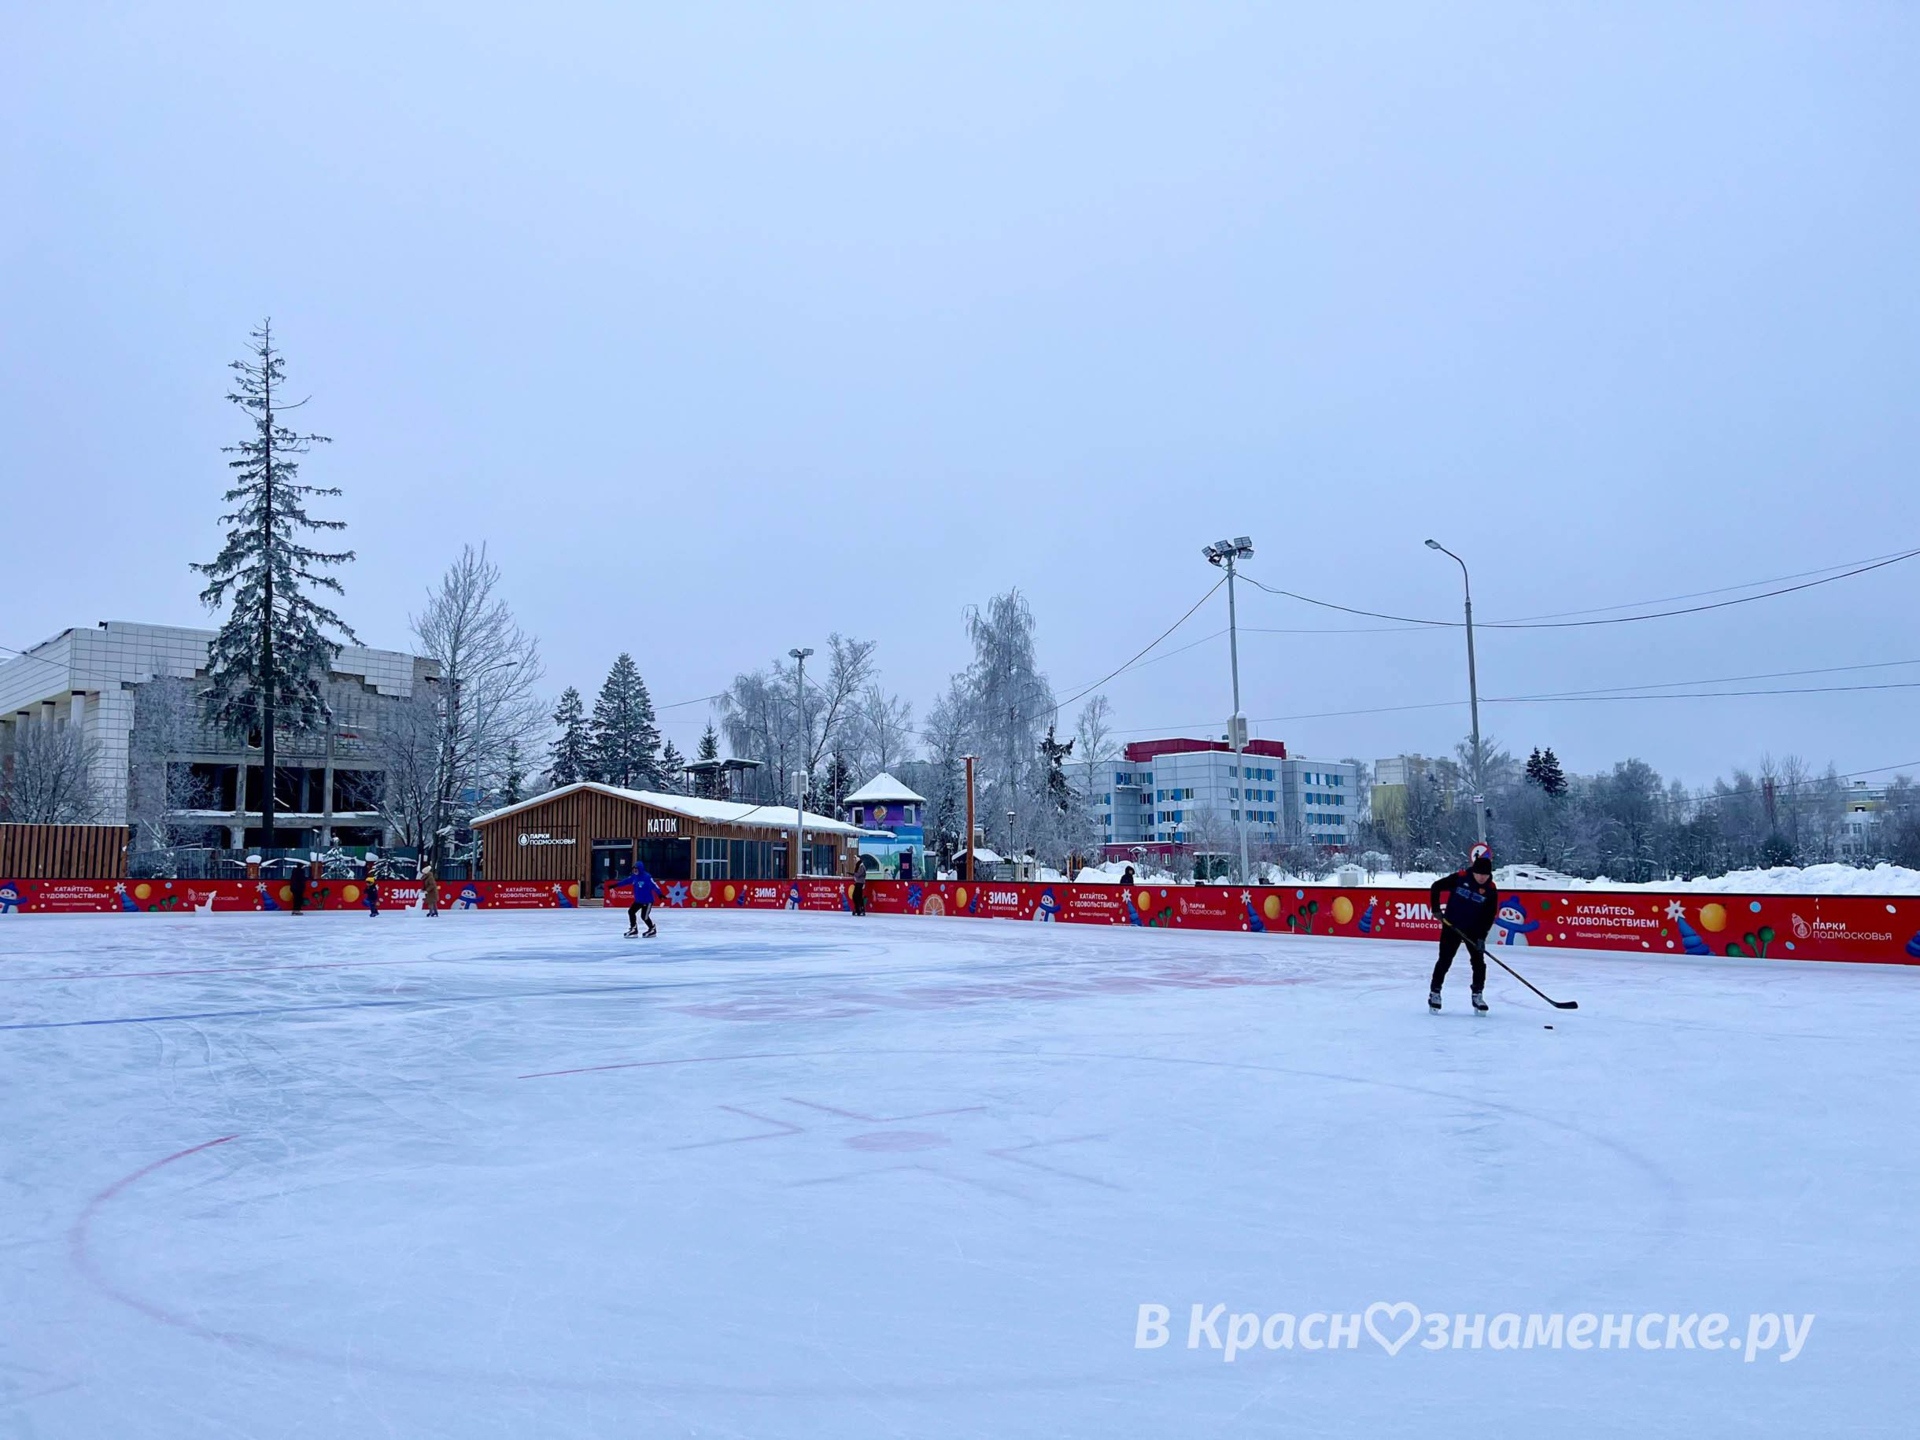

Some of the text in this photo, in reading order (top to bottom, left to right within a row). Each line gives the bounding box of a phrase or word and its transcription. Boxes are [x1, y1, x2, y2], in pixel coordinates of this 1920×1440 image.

[647, 818, 677, 833] КАТОК
[1079, 892, 1108, 900] КАТАЙТЕСЬ
[1576, 904, 1635, 916] КАТАЙТЕСЬ
[1556, 916, 1659, 928] С УДОВОЛЬСТВИЕМ!
[1812, 921, 1846, 930] ПАРКИ
[1812, 930, 1893, 941] ПОДМОСКОВЬЯ
